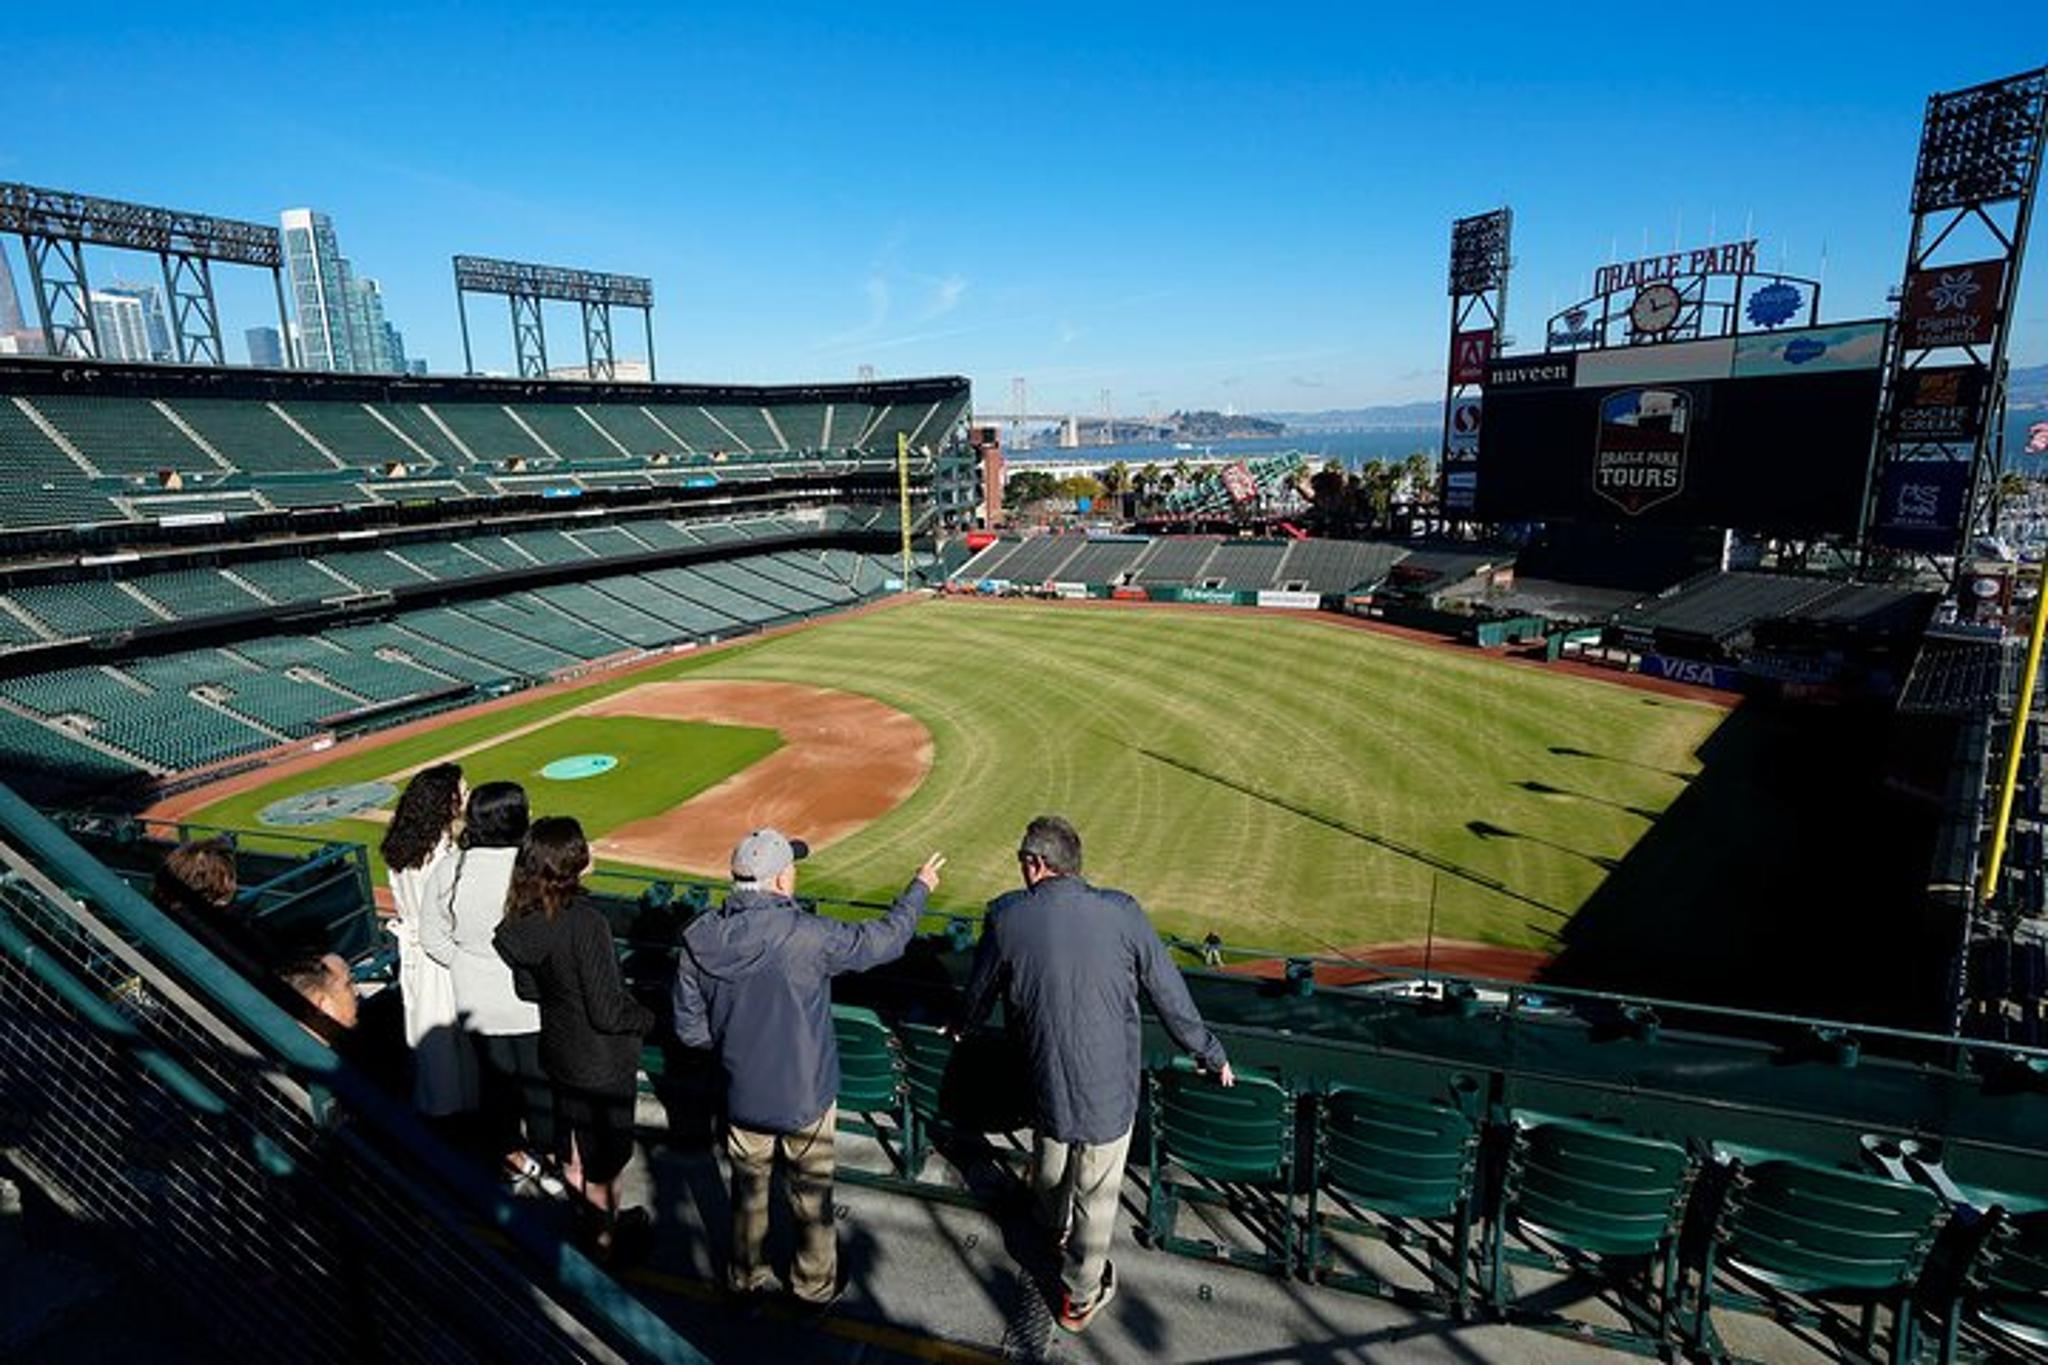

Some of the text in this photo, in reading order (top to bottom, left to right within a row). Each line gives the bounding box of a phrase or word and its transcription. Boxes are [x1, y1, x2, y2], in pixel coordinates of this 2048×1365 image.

[1595, 239, 1758, 297] ORACLE PARK
[1916, 313, 1981, 334] Dignity
[1916, 330, 1976, 347] Health
[1492, 363, 1568, 384] nuveen
[1900, 405, 1969, 419] CACHE
[1900, 418, 1963, 432] CREEK
[1600, 451, 1680, 468] ORACLE PARK
[1599, 467, 1678, 487] TOURS
[1660, 659, 1715, 685] VISA
